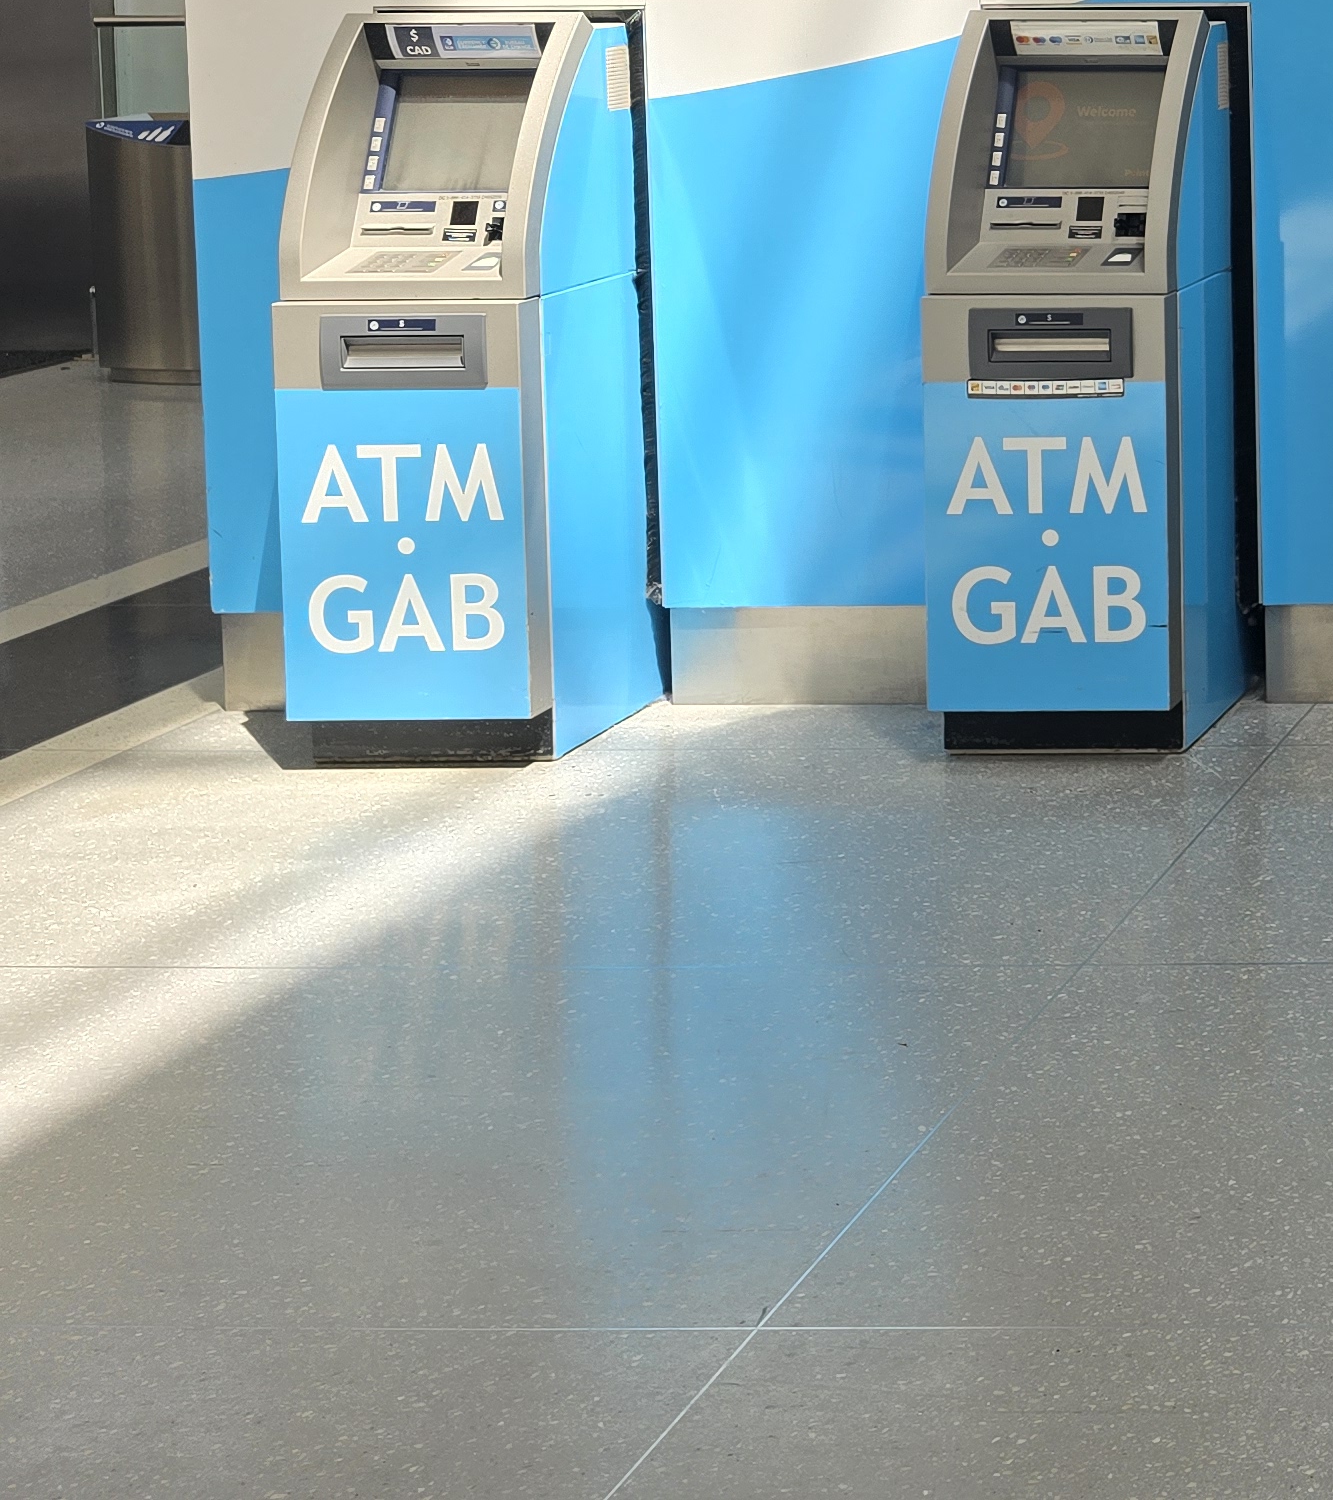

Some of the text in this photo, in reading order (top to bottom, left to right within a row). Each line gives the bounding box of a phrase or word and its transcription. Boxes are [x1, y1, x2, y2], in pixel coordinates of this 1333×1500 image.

[406, 45, 432, 56] CAD
[409, 28, 419, 43] $
[1077, 105, 1137, 117] Welcome
[301, 442, 505, 524] ATM
[946, 435, 1149, 515] ATM
[307, 572, 506, 655] GAB
[951, 564, 1148, 646] GAB
